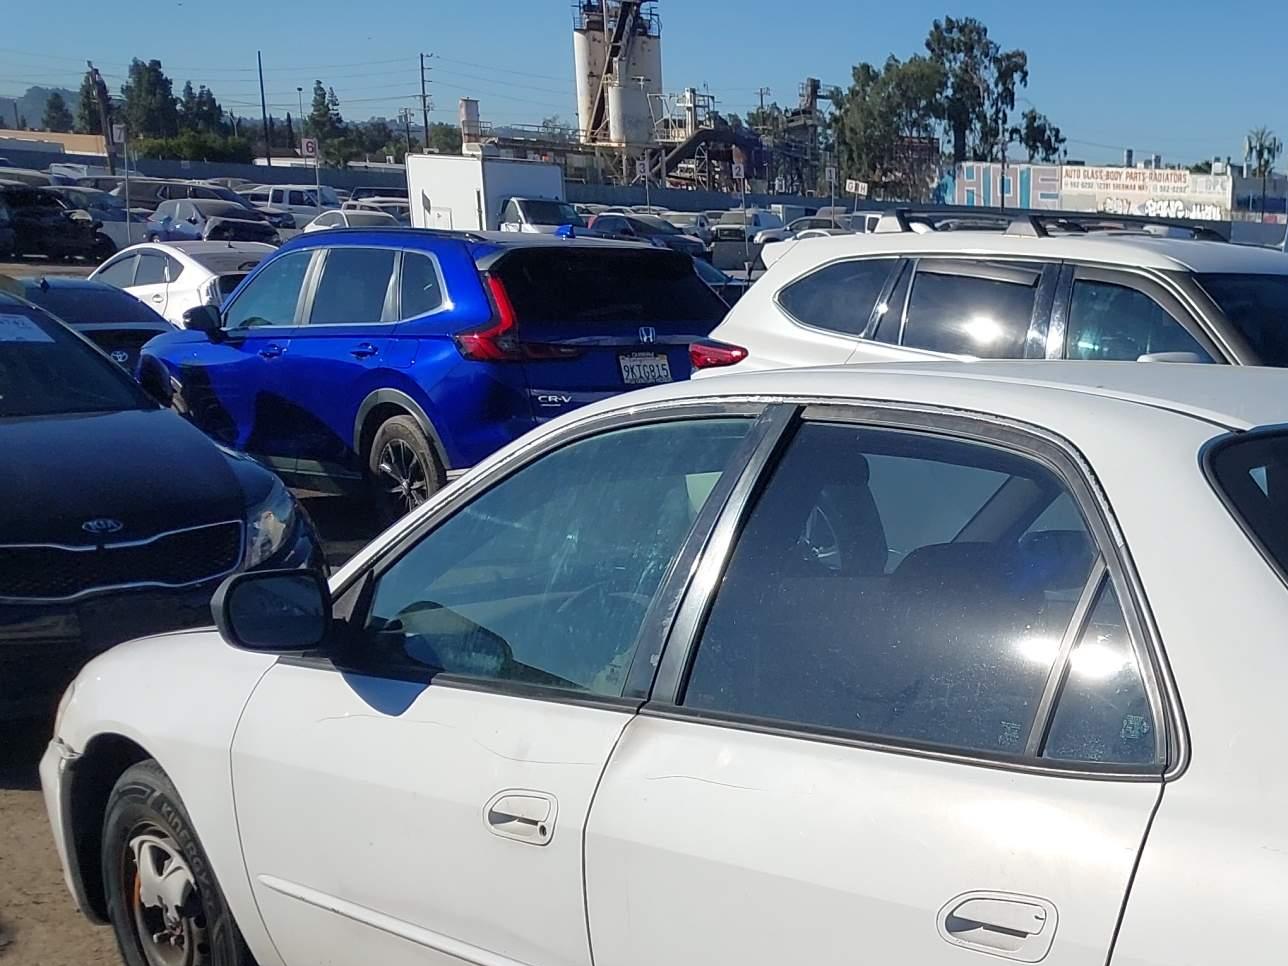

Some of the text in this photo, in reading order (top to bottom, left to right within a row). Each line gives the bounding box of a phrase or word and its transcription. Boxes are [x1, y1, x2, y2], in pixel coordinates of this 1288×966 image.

[306, 141, 314, 153] 6
[1064, 169, 1081, 179] AUTO
[538, 395, 572, 403] CR-V
